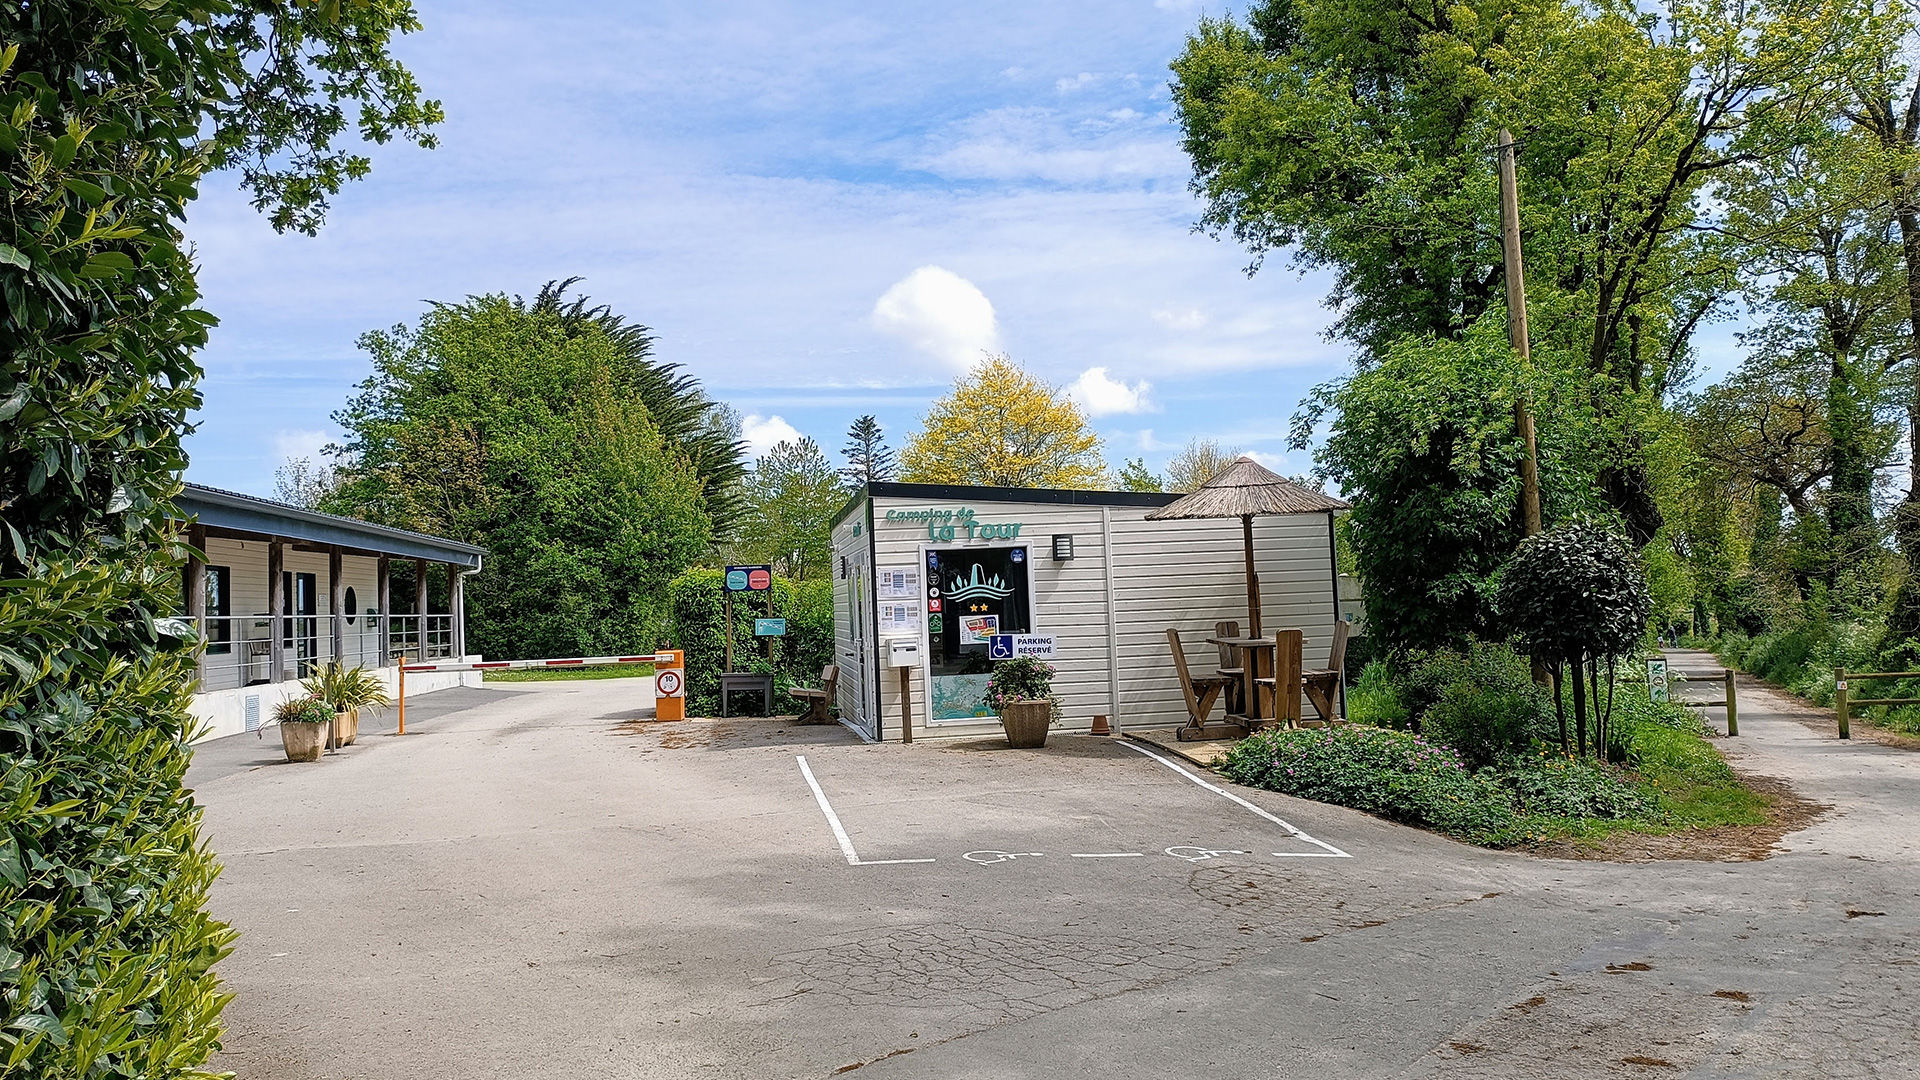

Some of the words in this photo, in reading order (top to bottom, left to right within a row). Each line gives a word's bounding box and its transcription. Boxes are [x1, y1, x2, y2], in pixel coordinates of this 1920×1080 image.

[886, 508, 952, 522] Camping
[957, 507, 975, 520] de
[963, 520, 1022, 540] Tour
[1018, 646, 1052, 654] RÉSERVÉ
